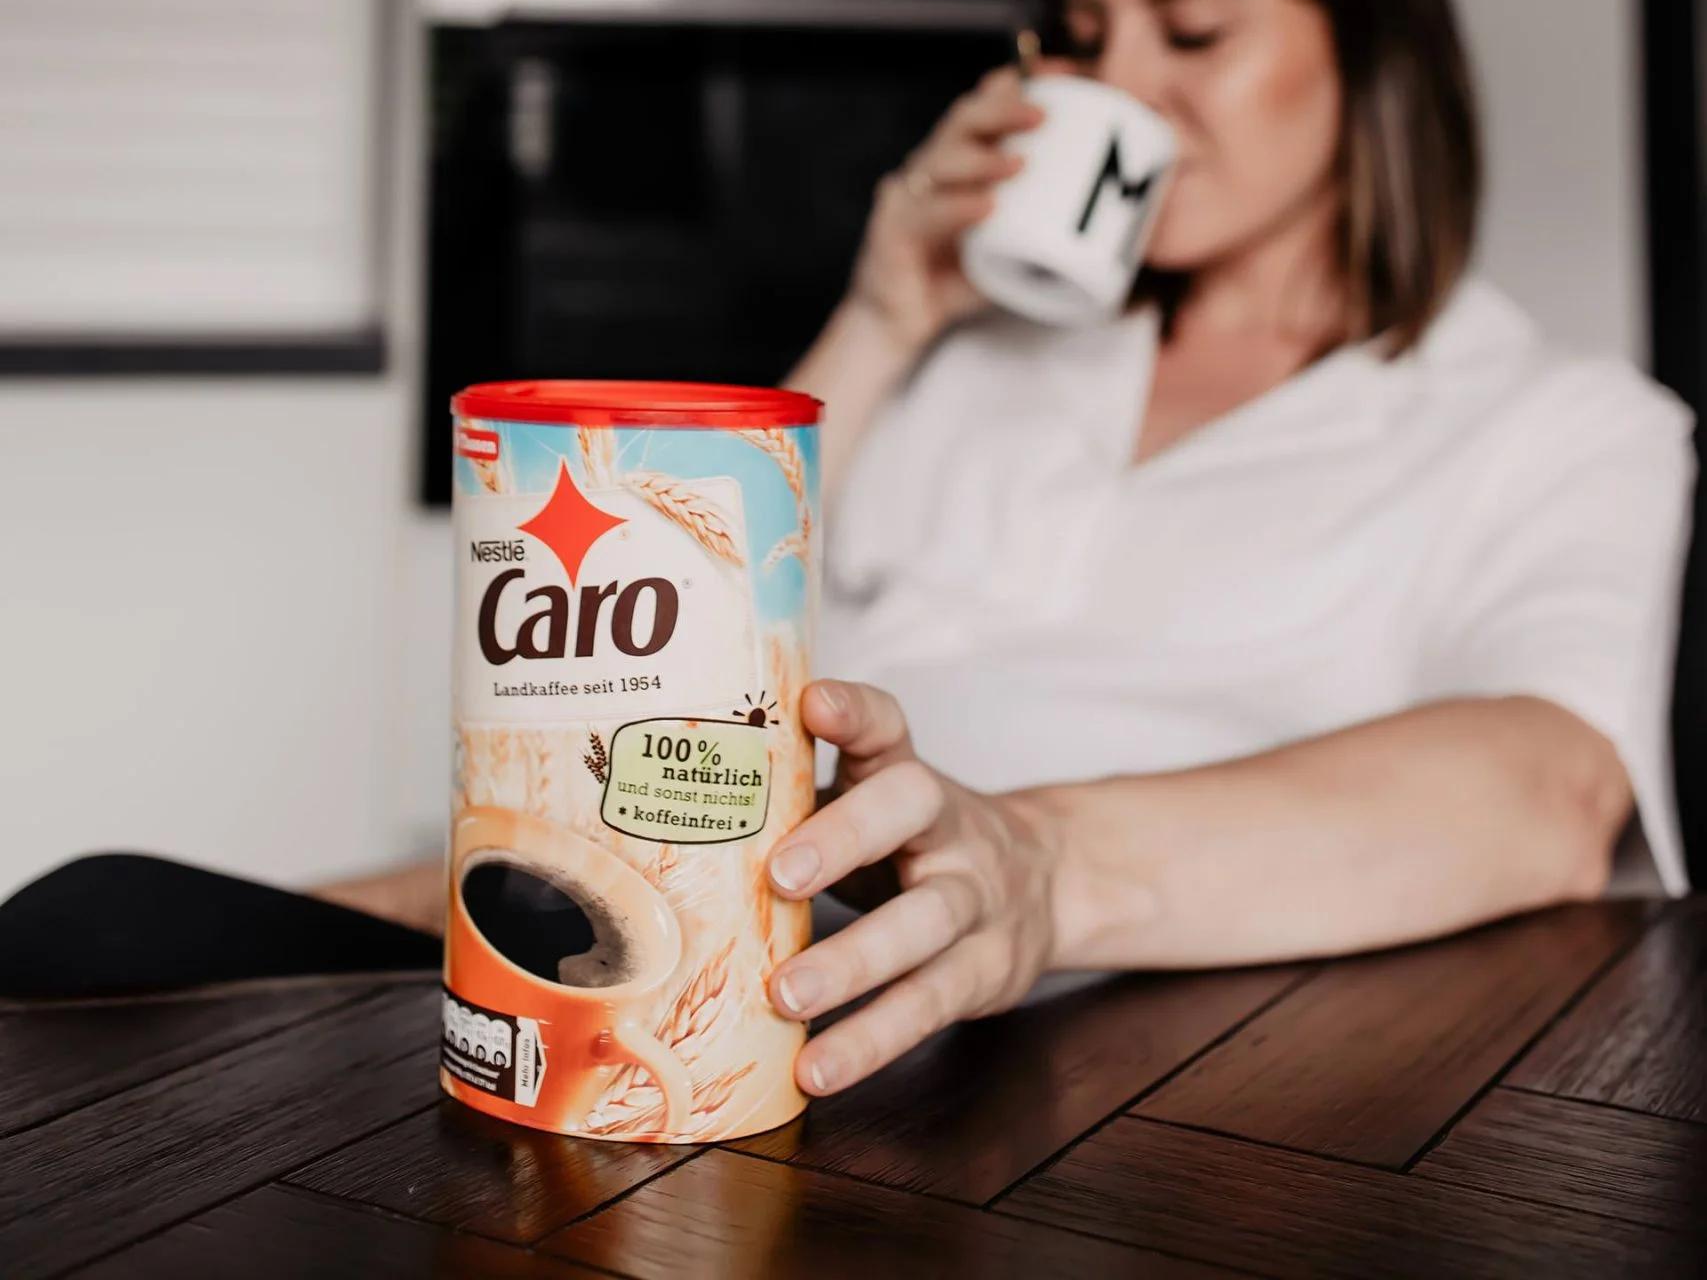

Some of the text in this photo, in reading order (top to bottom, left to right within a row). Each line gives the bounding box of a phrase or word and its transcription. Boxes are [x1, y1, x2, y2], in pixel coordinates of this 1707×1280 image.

[470, 539, 525, 563] Nestlé
[478, 568, 679, 666] Caro
[493, 674, 662, 697] Landkaffee seit 1954
[661, 765, 762, 787] natürlich
[617, 780, 756, 807] und sonst nichts!
[633, 805, 733, 831] koffeinfrei
